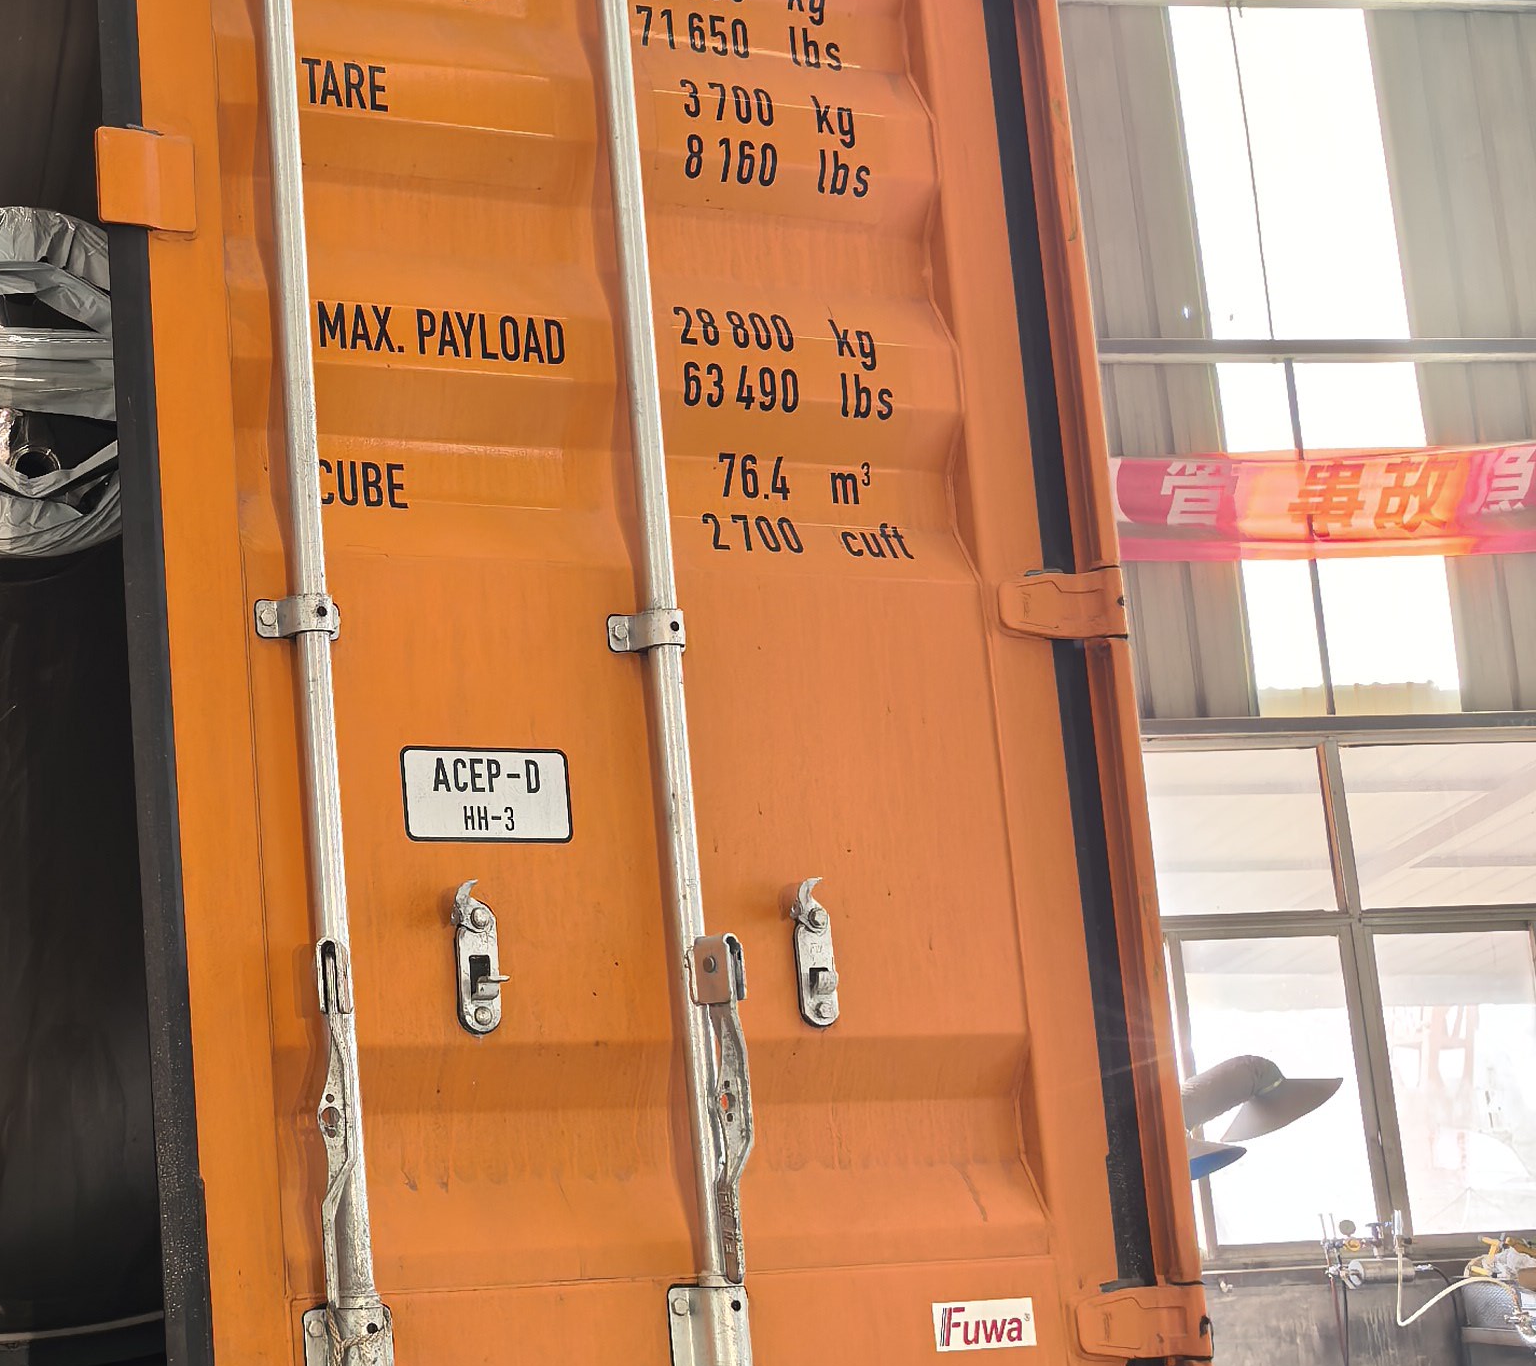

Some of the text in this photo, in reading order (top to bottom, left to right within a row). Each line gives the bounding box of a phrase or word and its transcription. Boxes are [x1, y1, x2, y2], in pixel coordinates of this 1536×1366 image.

[788, 26, 842, 71] lbs
[301, 57, 389, 113] TARE
[810, 95, 856, 149] kg
[817, 148, 871, 198] lbs
[317, 300, 405, 353] MAX.
[416, 308, 566, 365] PAYLOAD
[834, 319, 877, 371] kg
[840, 372, 893, 421] lbs
[318, 458, 409, 509] CUBE
[718, 452, 791, 501] 76.4
[841, 522, 915, 560] cuft
[462, 804, 516, 831] HH-3
[939, 1306, 1024, 1346] Fuwa
